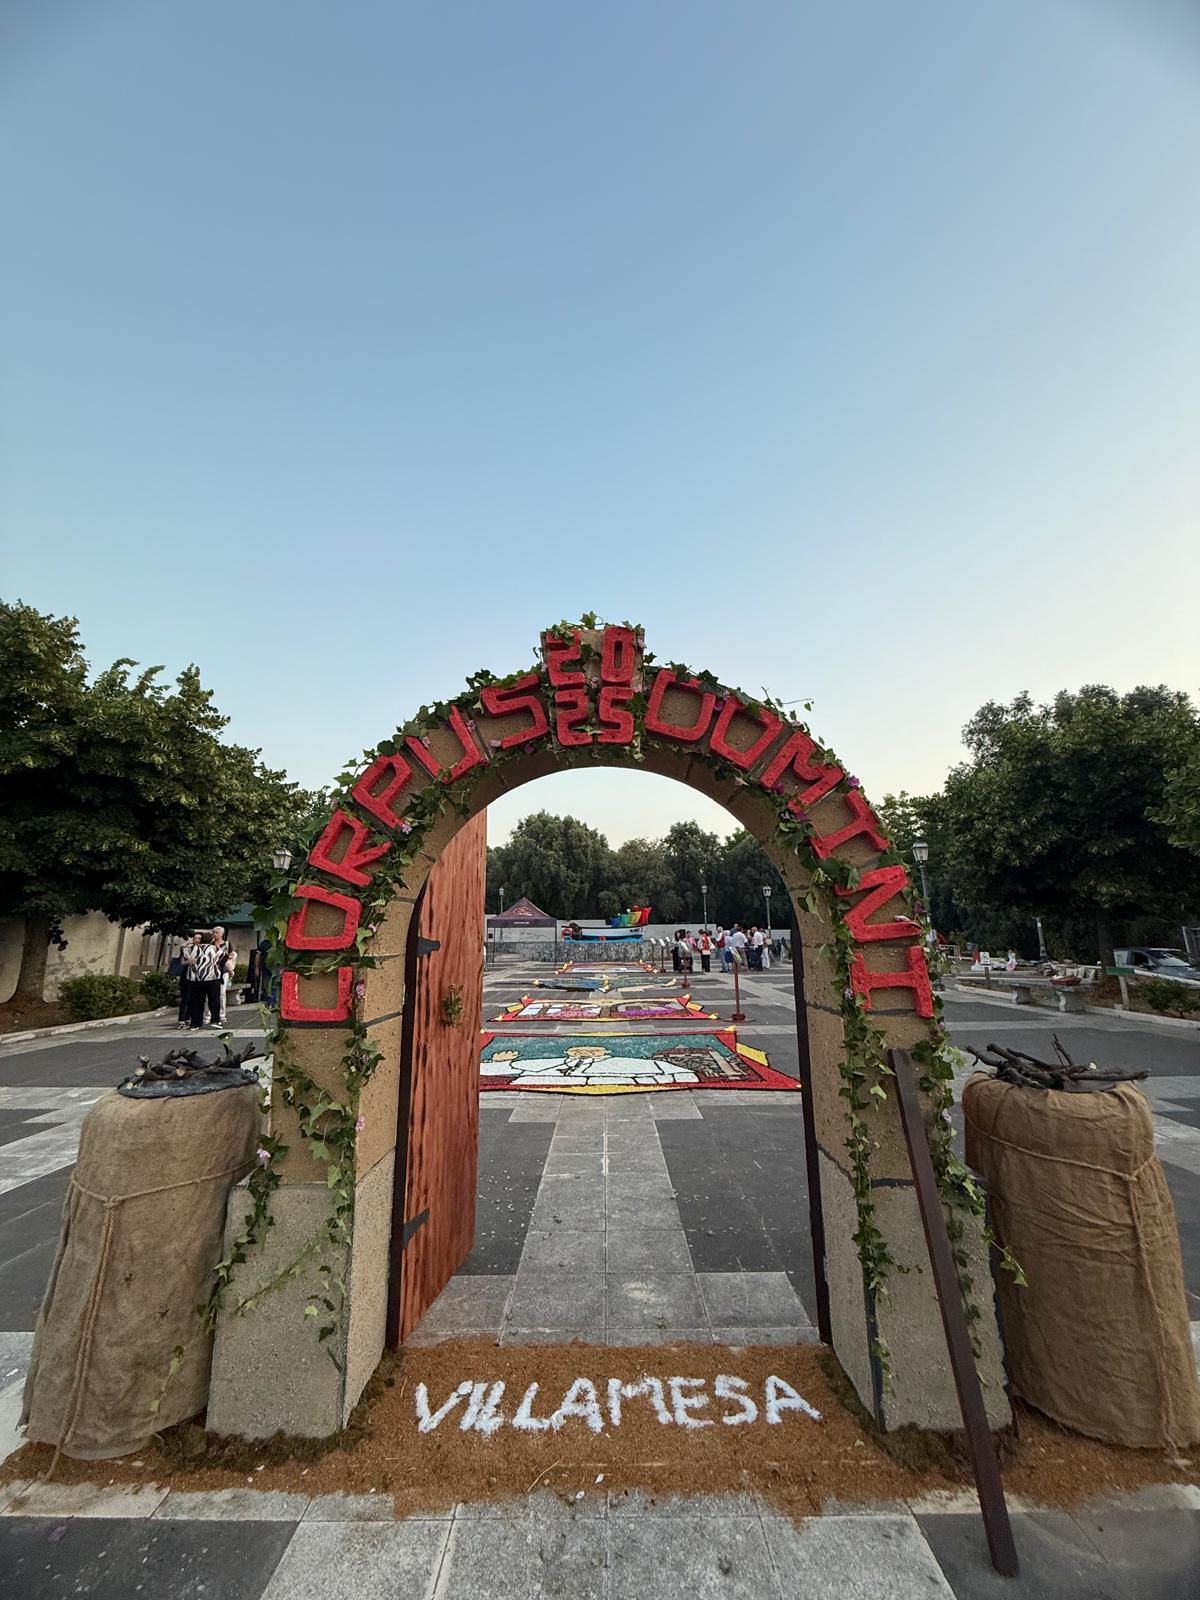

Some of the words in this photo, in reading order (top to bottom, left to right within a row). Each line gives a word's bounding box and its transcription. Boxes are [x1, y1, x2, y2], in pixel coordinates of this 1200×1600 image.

[546, 626, 636, 687] 20
[554, 686, 635, 746] 25
[280, 674, 549, 1022] CORPUS
[644, 668, 934, 1019] DOMINI
[415, 1374, 822, 1434] VILLAMESA
